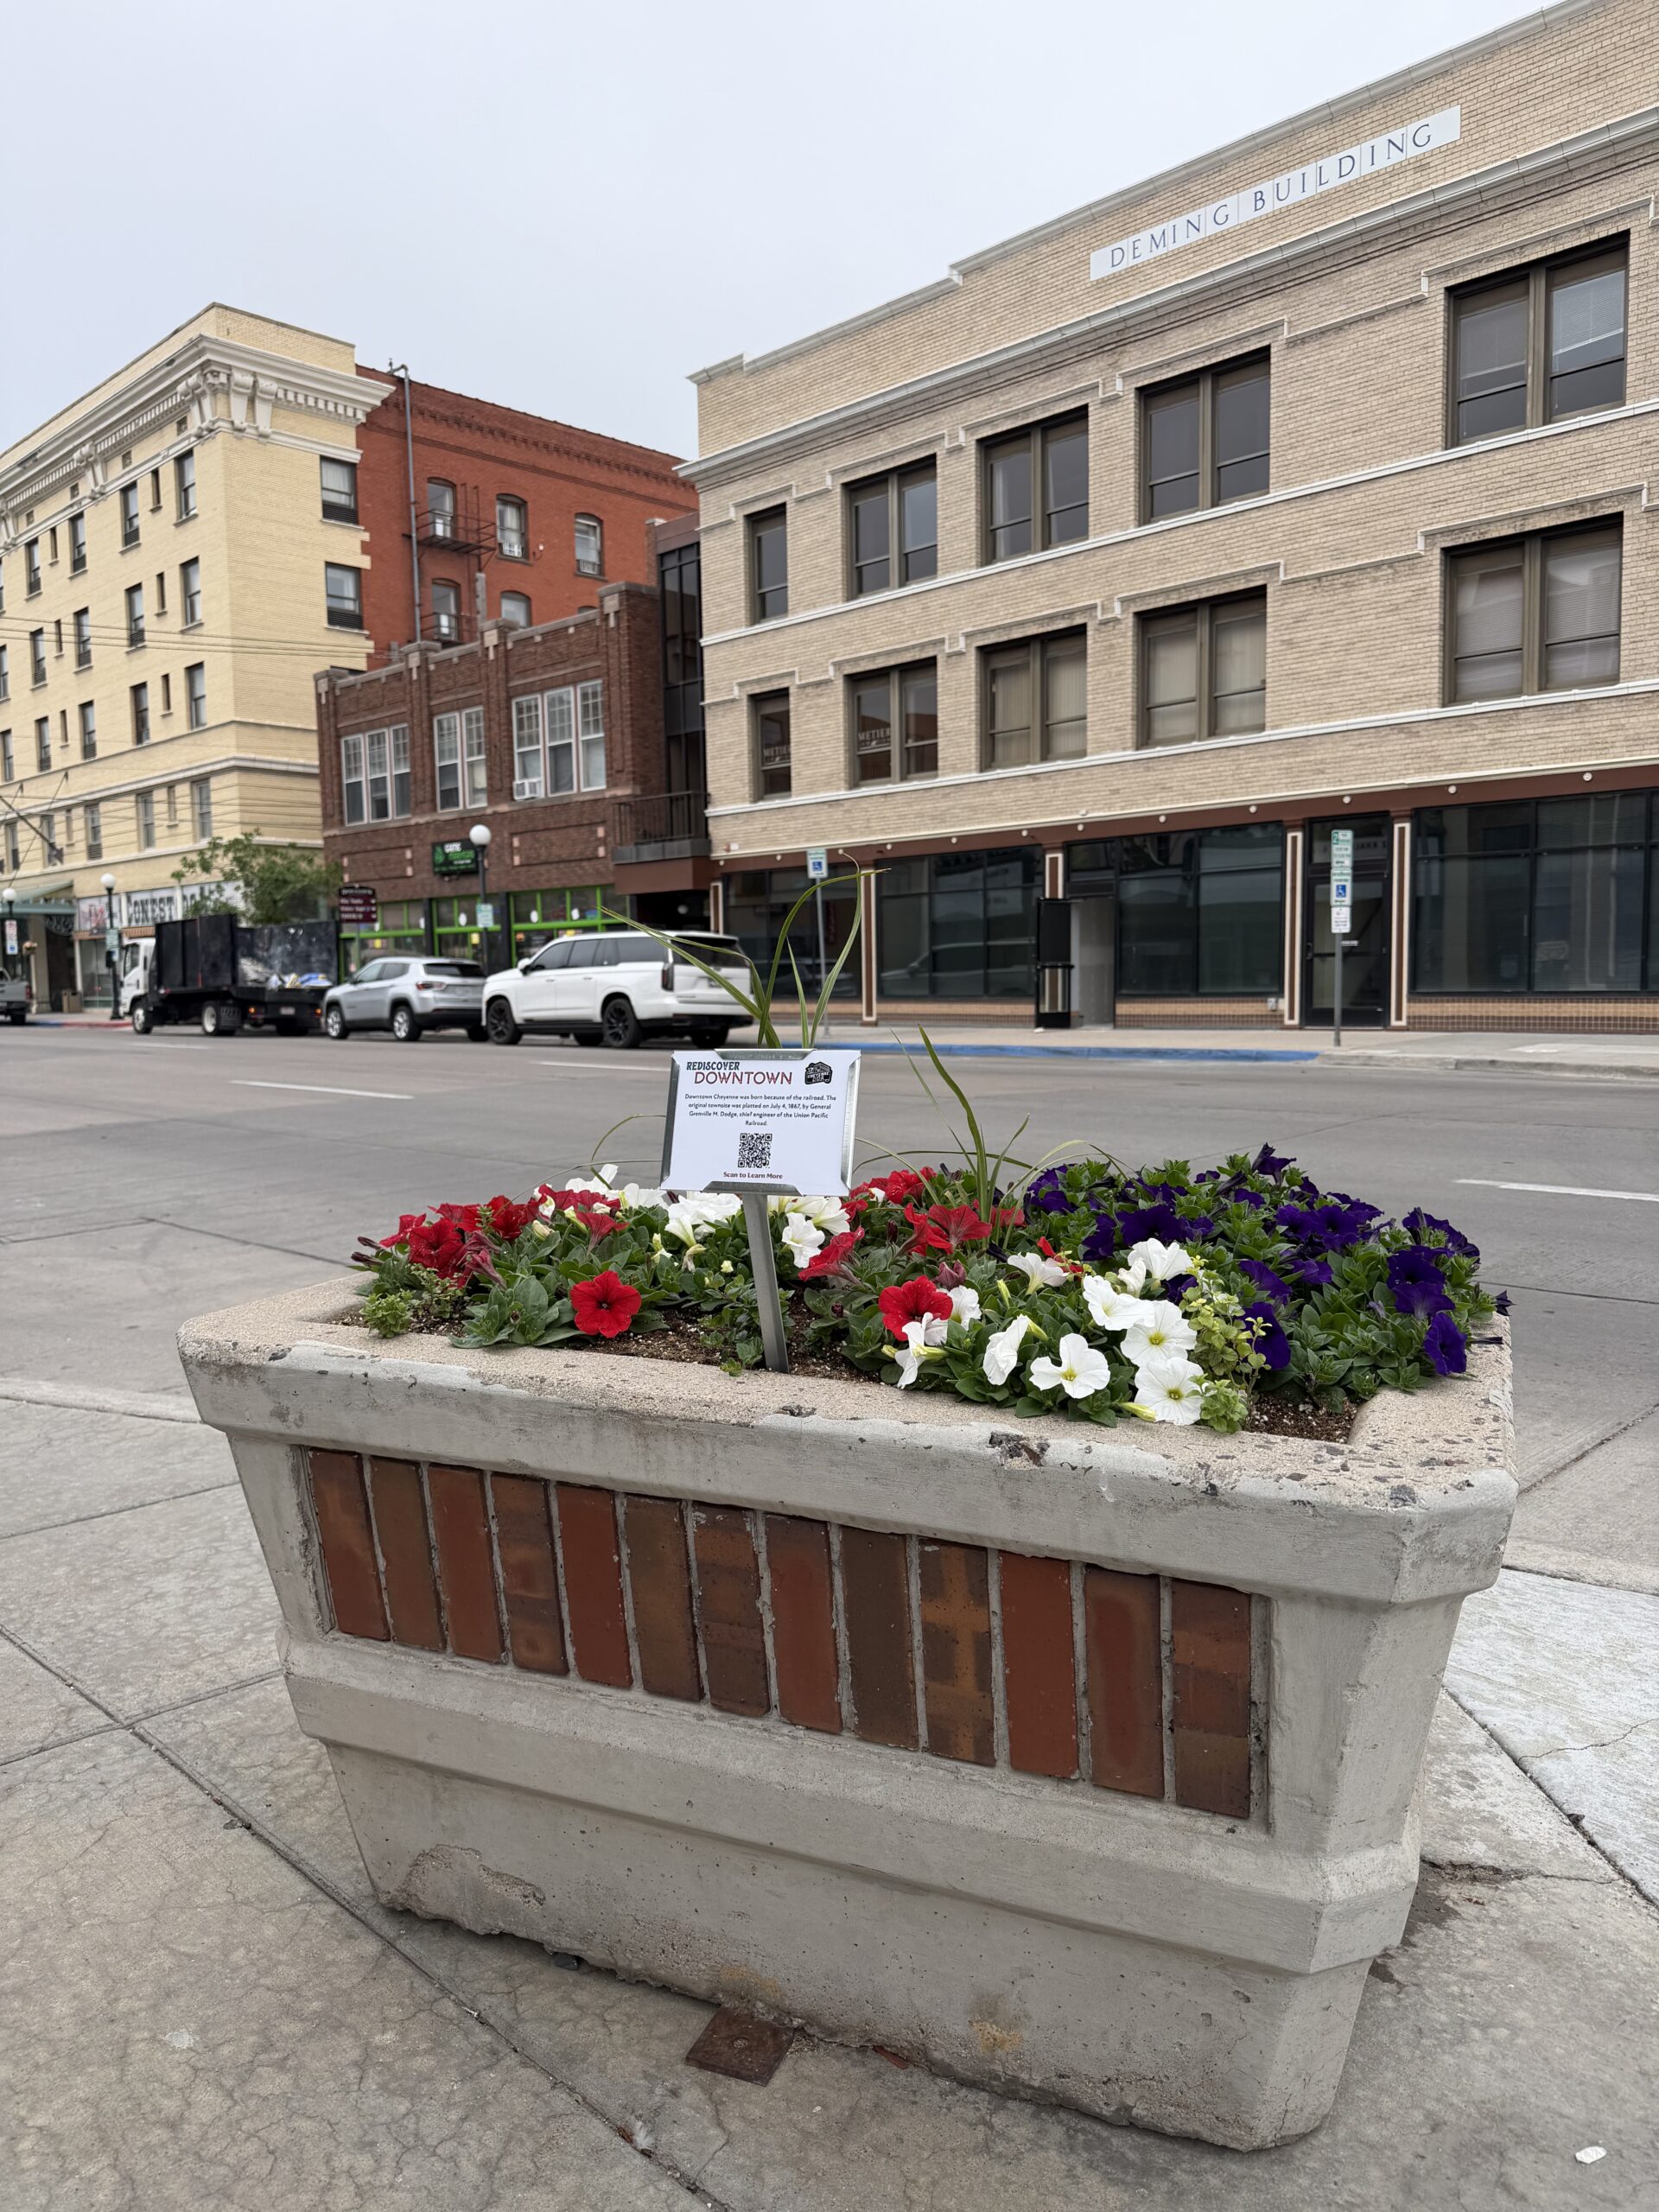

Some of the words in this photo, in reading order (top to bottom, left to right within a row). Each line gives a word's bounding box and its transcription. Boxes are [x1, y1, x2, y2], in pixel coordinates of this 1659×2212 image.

[1110, 204, 1230, 268] DEMING
[1253, 124, 1432, 212] BUILDING
[686, 1061, 741, 1071] REDISCOVER
[694, 1071, 792, 1084] DOWNTOWN
